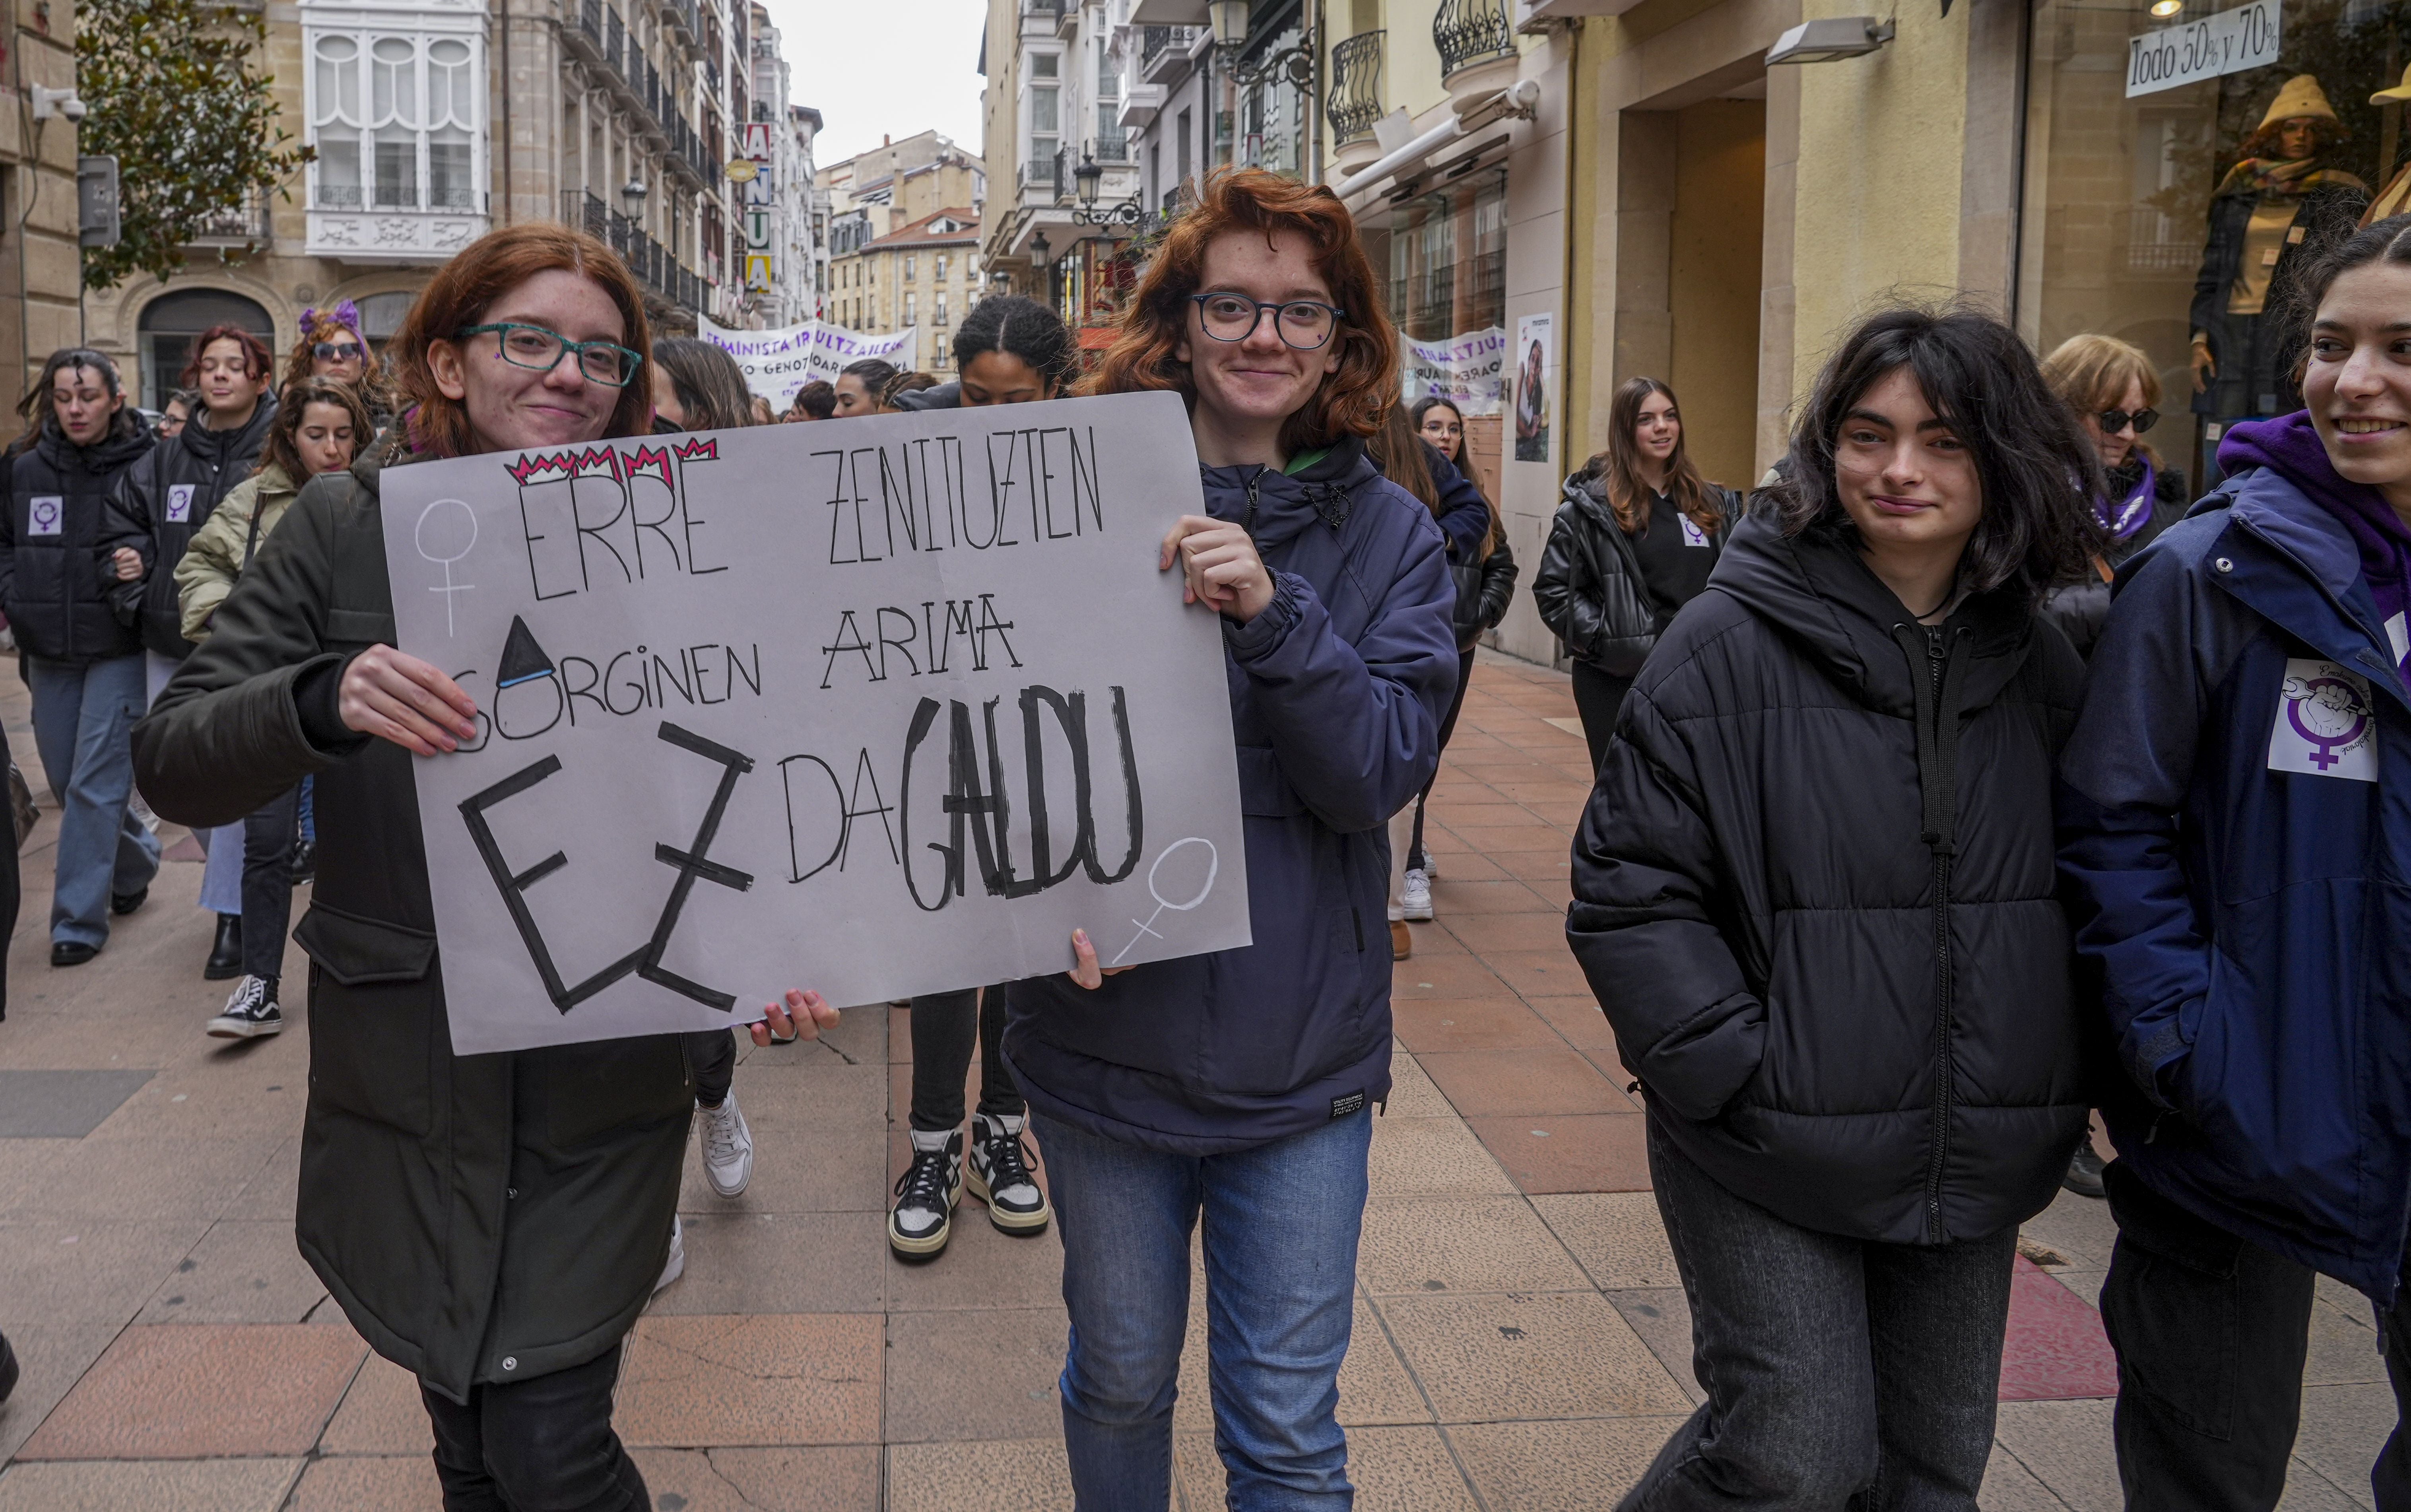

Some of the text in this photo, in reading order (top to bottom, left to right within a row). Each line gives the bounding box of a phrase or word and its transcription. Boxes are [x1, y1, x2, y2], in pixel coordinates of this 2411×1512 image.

[2131, 4, 2277, 85] Todo 50% y 70%
[707, 331, 790, 356] FEMINISTA
[518, 425, 1103, 601] ERRE ZENITUZTEN
[820, 593, 1023, 689] ARIMA
[458, 685, 1144, 1016] EZ DA GALDU
